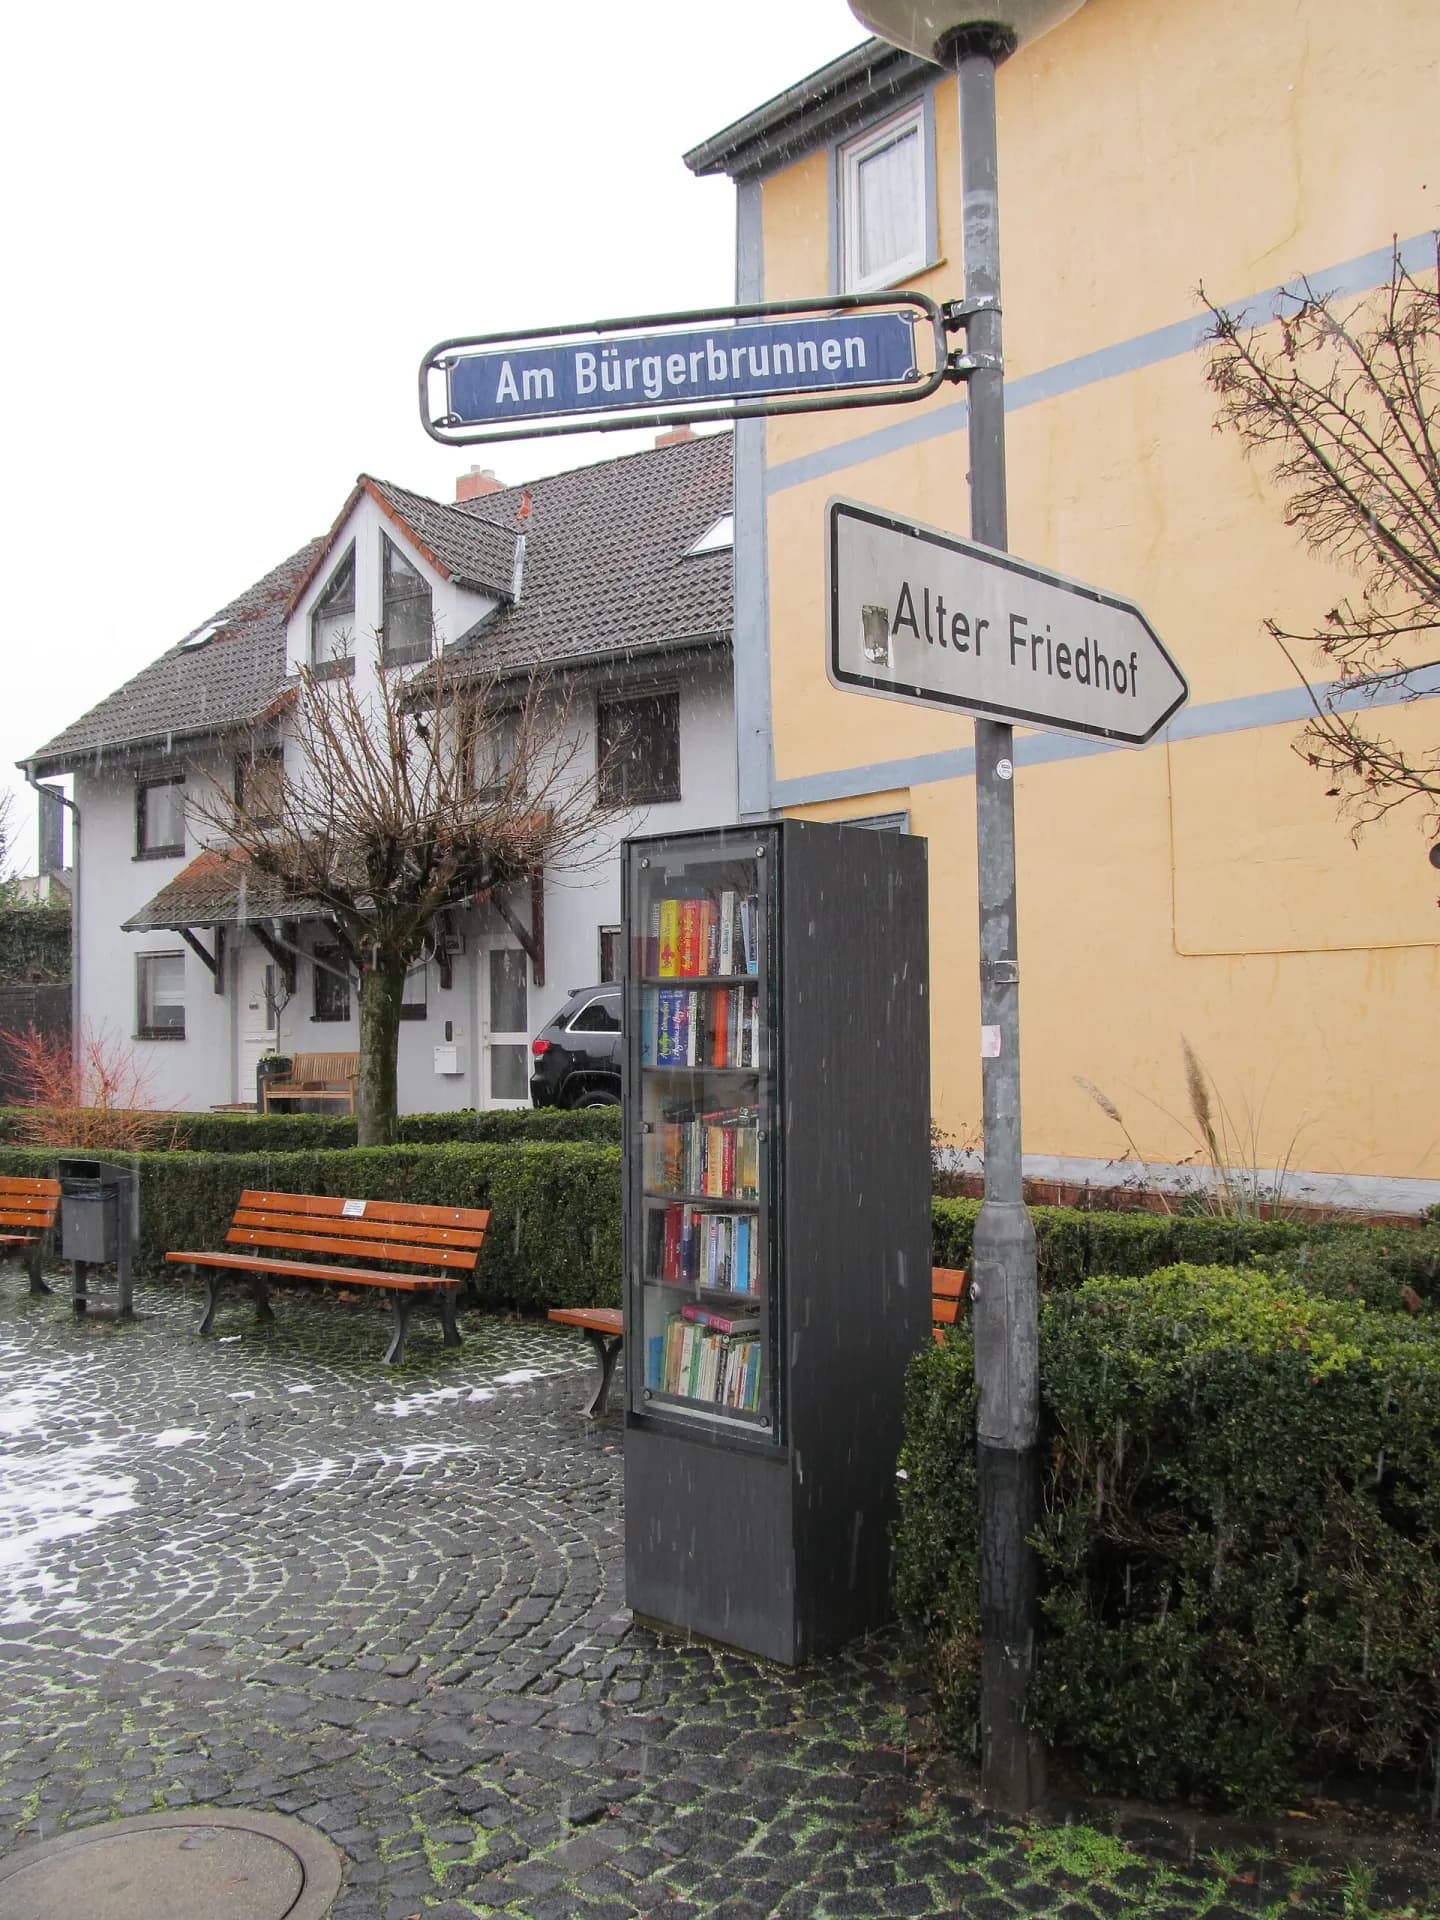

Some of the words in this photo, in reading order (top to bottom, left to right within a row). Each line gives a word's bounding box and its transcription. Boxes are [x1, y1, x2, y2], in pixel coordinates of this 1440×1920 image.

[495, 360, 554, 405] Am
[575, 335, 867, 400] Bürgerbrunnen
[891, 581, 990, 657] Alter
[1008, 612, 1138, 698] Friedhof
